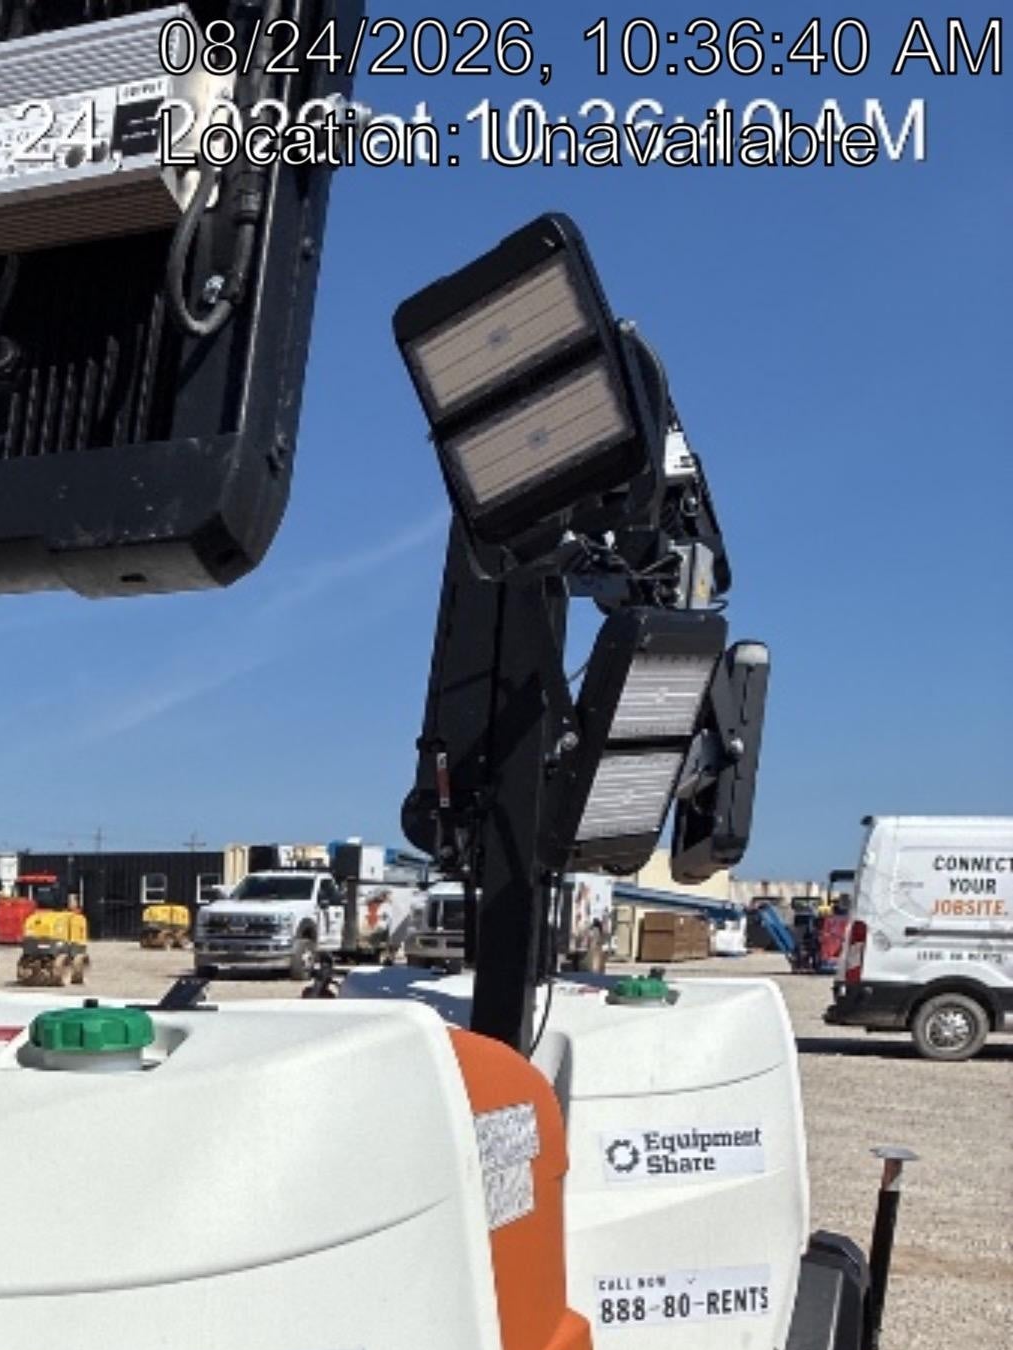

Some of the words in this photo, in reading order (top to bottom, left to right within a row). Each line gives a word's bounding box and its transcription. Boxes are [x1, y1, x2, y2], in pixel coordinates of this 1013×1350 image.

[933, 855, 1013, 872] CONNECT
[949, 877, 997, 894] YOUR
[932, 898, 1009, 916] JOBSITE.
[642, 1127, 762, 1153] Equipment
[646, 1154, 716, 1174] Share
[599, 1278, 631, 1291] CALL
[601, 1286, 768, 1324] 888-80-RENTS
